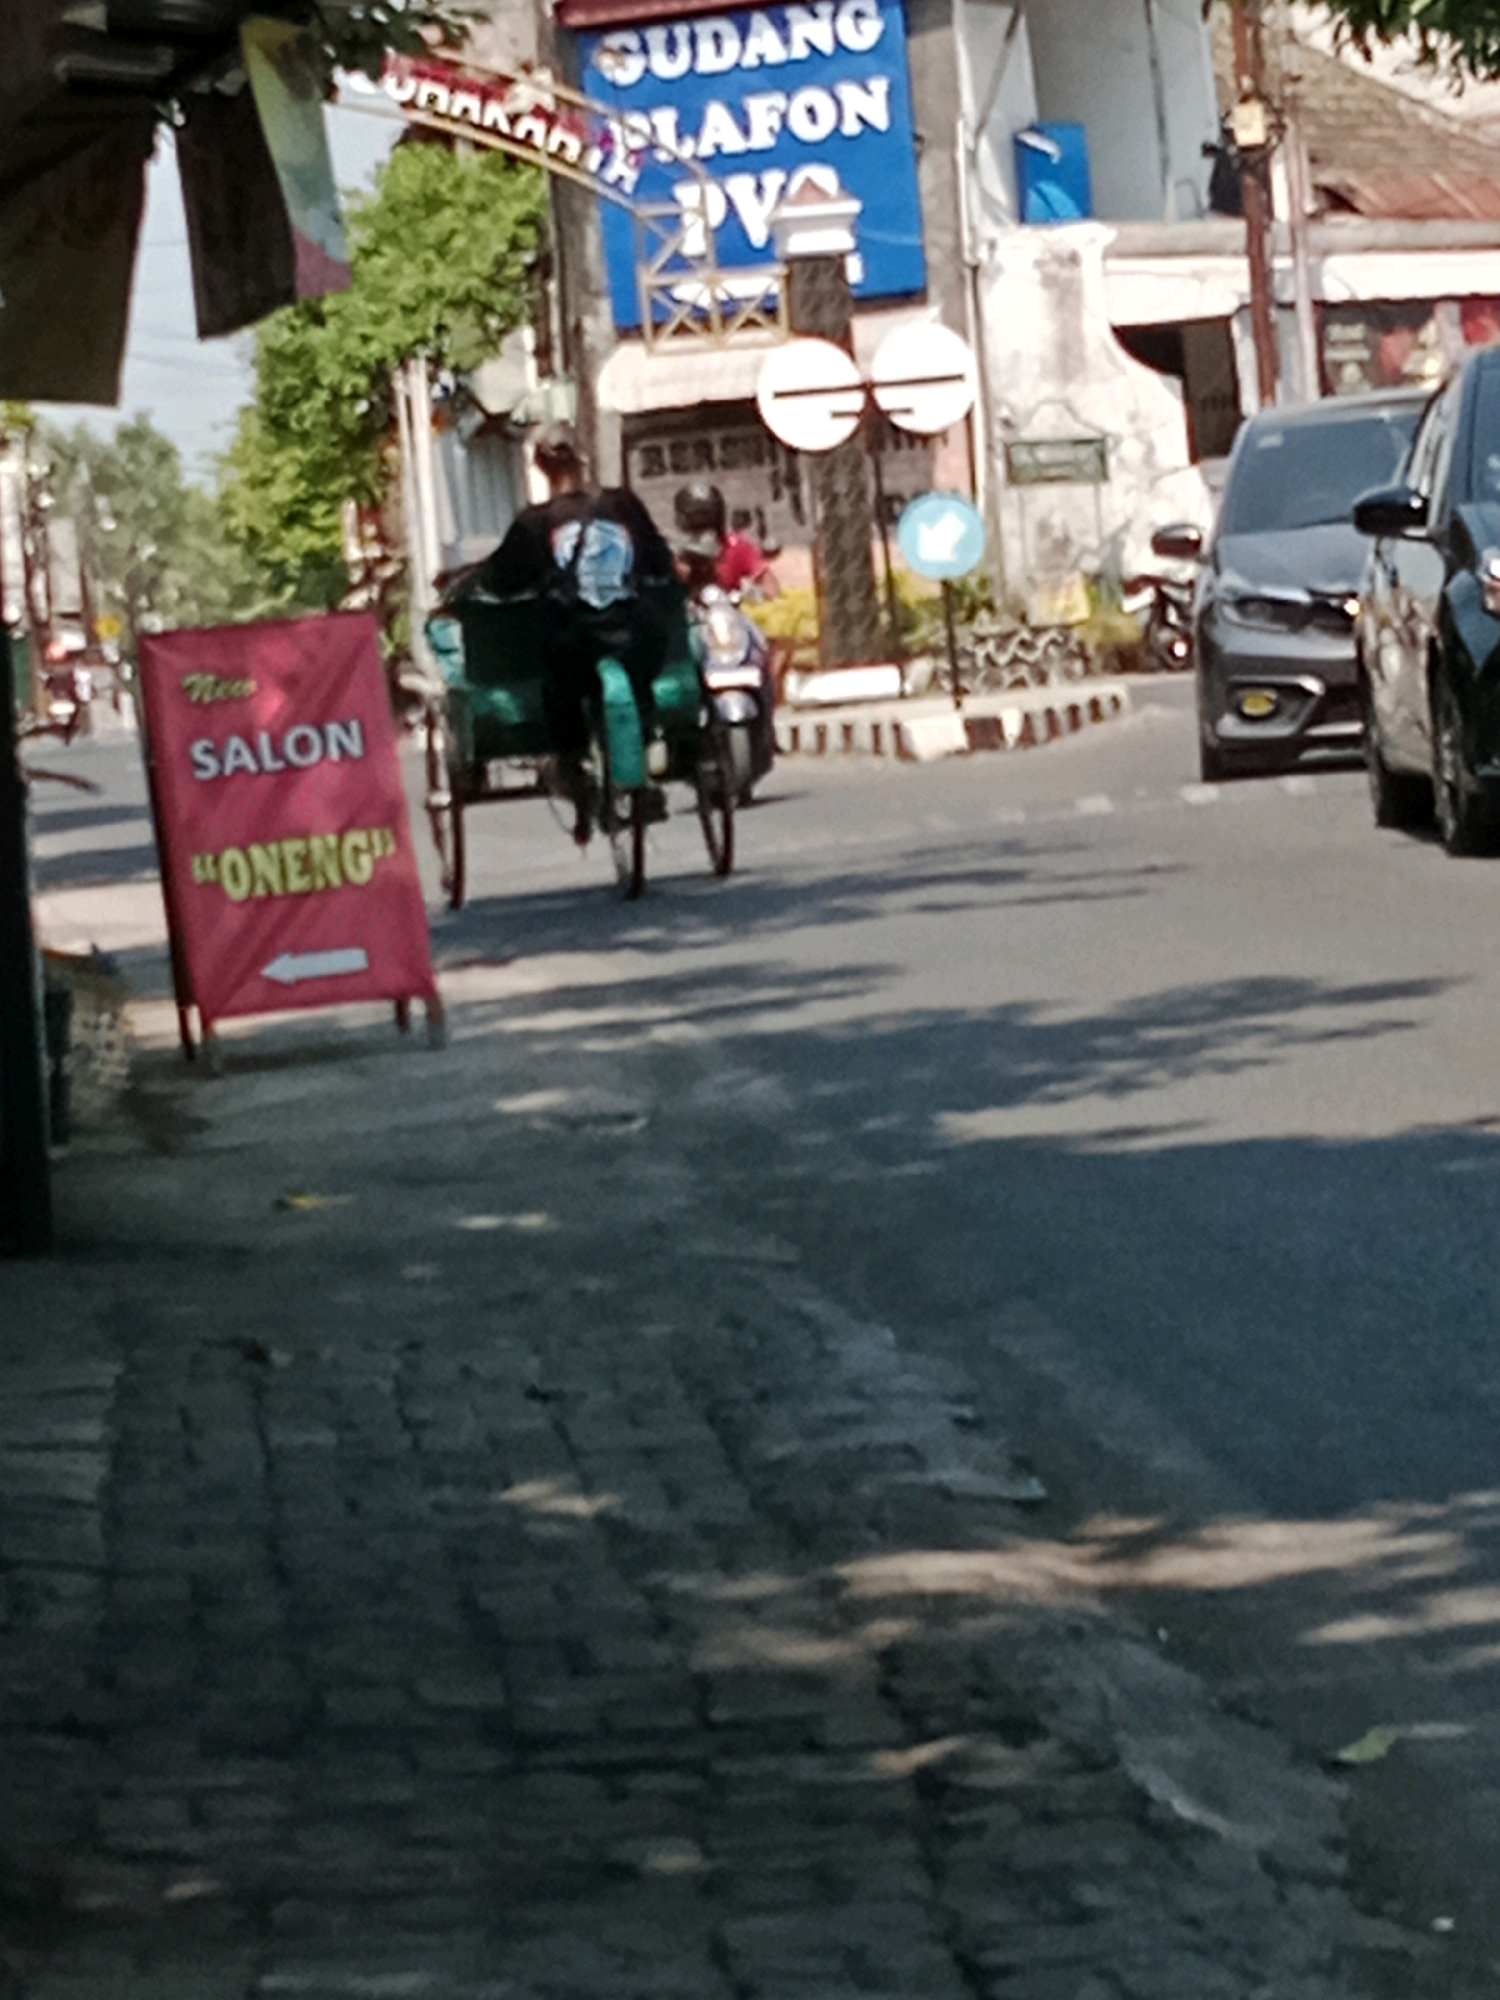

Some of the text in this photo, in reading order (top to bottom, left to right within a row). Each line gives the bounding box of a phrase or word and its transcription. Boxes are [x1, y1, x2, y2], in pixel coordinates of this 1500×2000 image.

[596, 0, 885, 87] GUDANG
[606, 76, 891, 163] PLAFON
[190, 718, 365, 781] SALON
